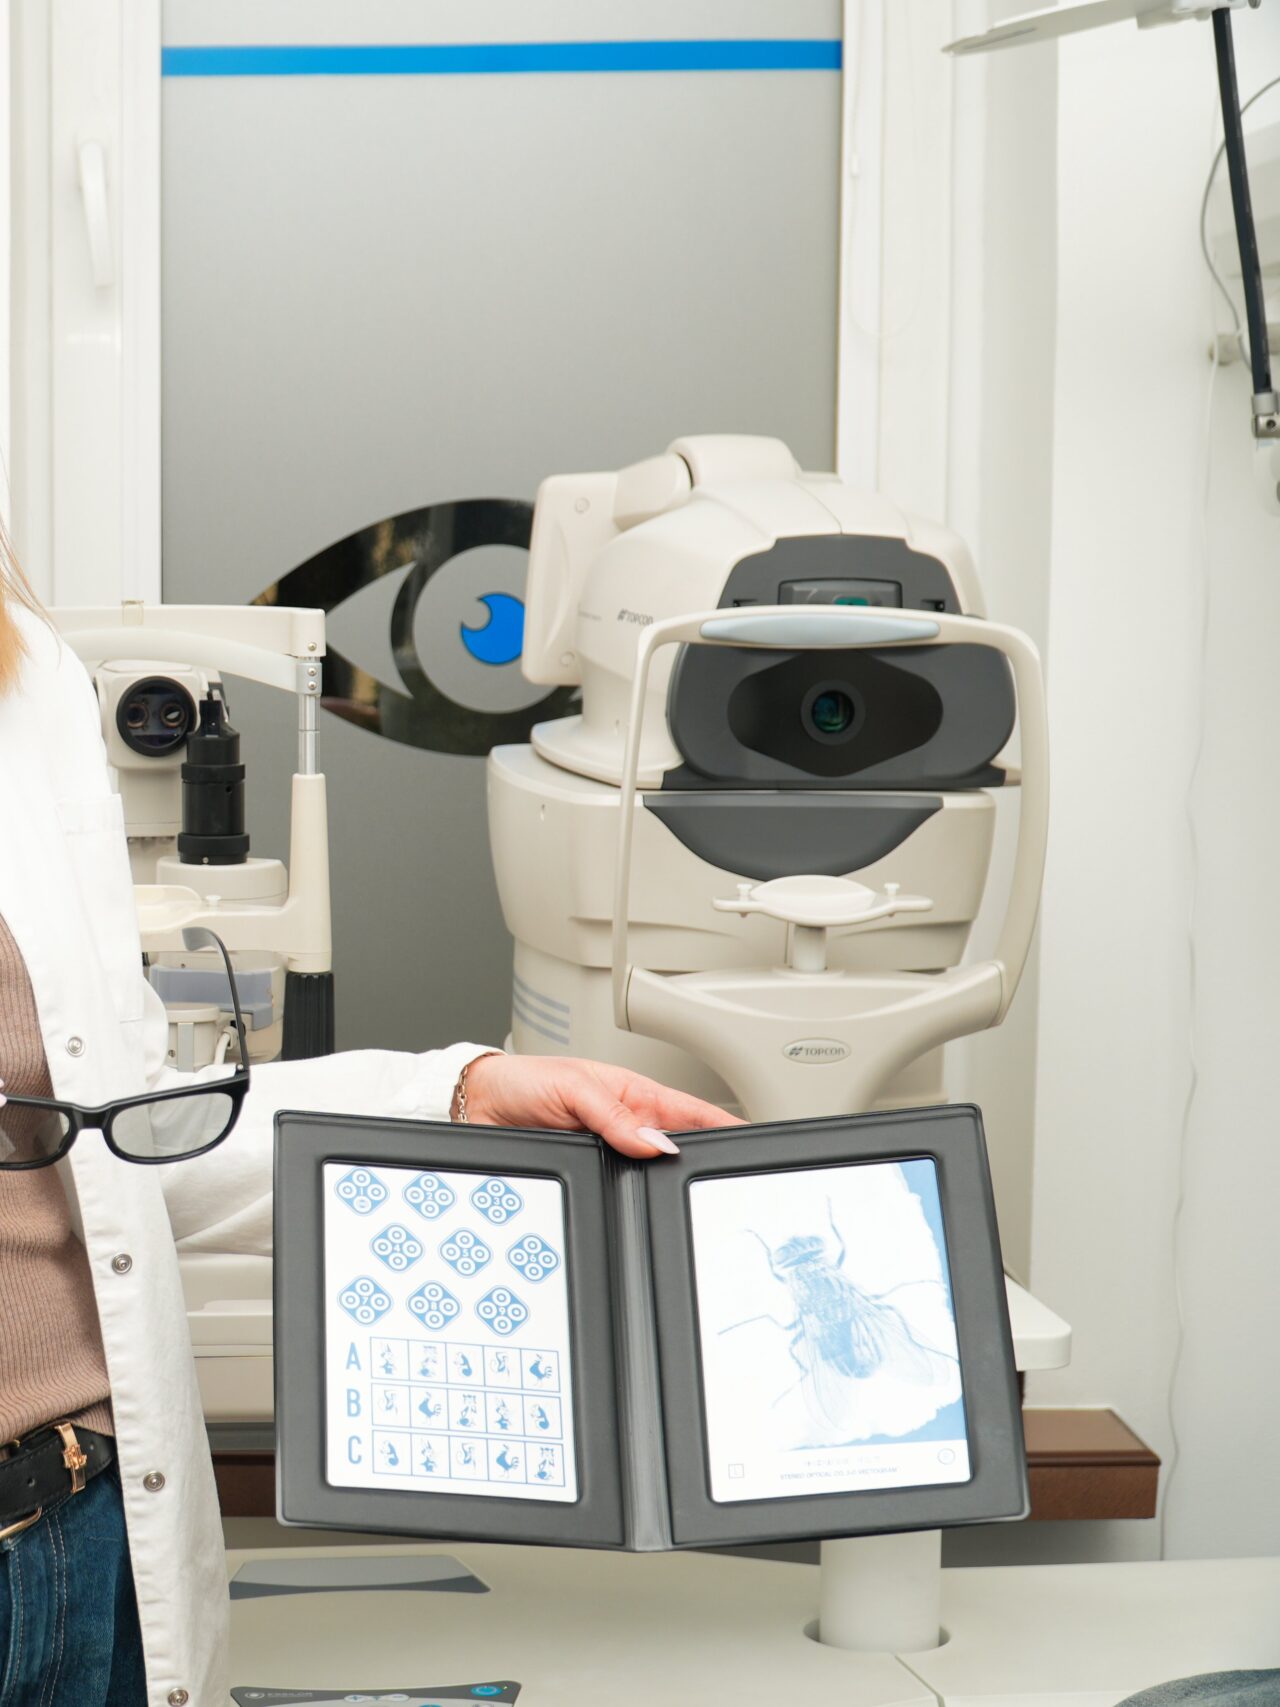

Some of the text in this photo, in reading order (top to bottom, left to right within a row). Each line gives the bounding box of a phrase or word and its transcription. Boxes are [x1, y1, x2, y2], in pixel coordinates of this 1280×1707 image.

[805, 1047, 846, 1056] TOPCON
[345, 1341, 362, 1371] A
[346, 1388, 362, 1418] B
[347, 1435, 363, 1465] C
